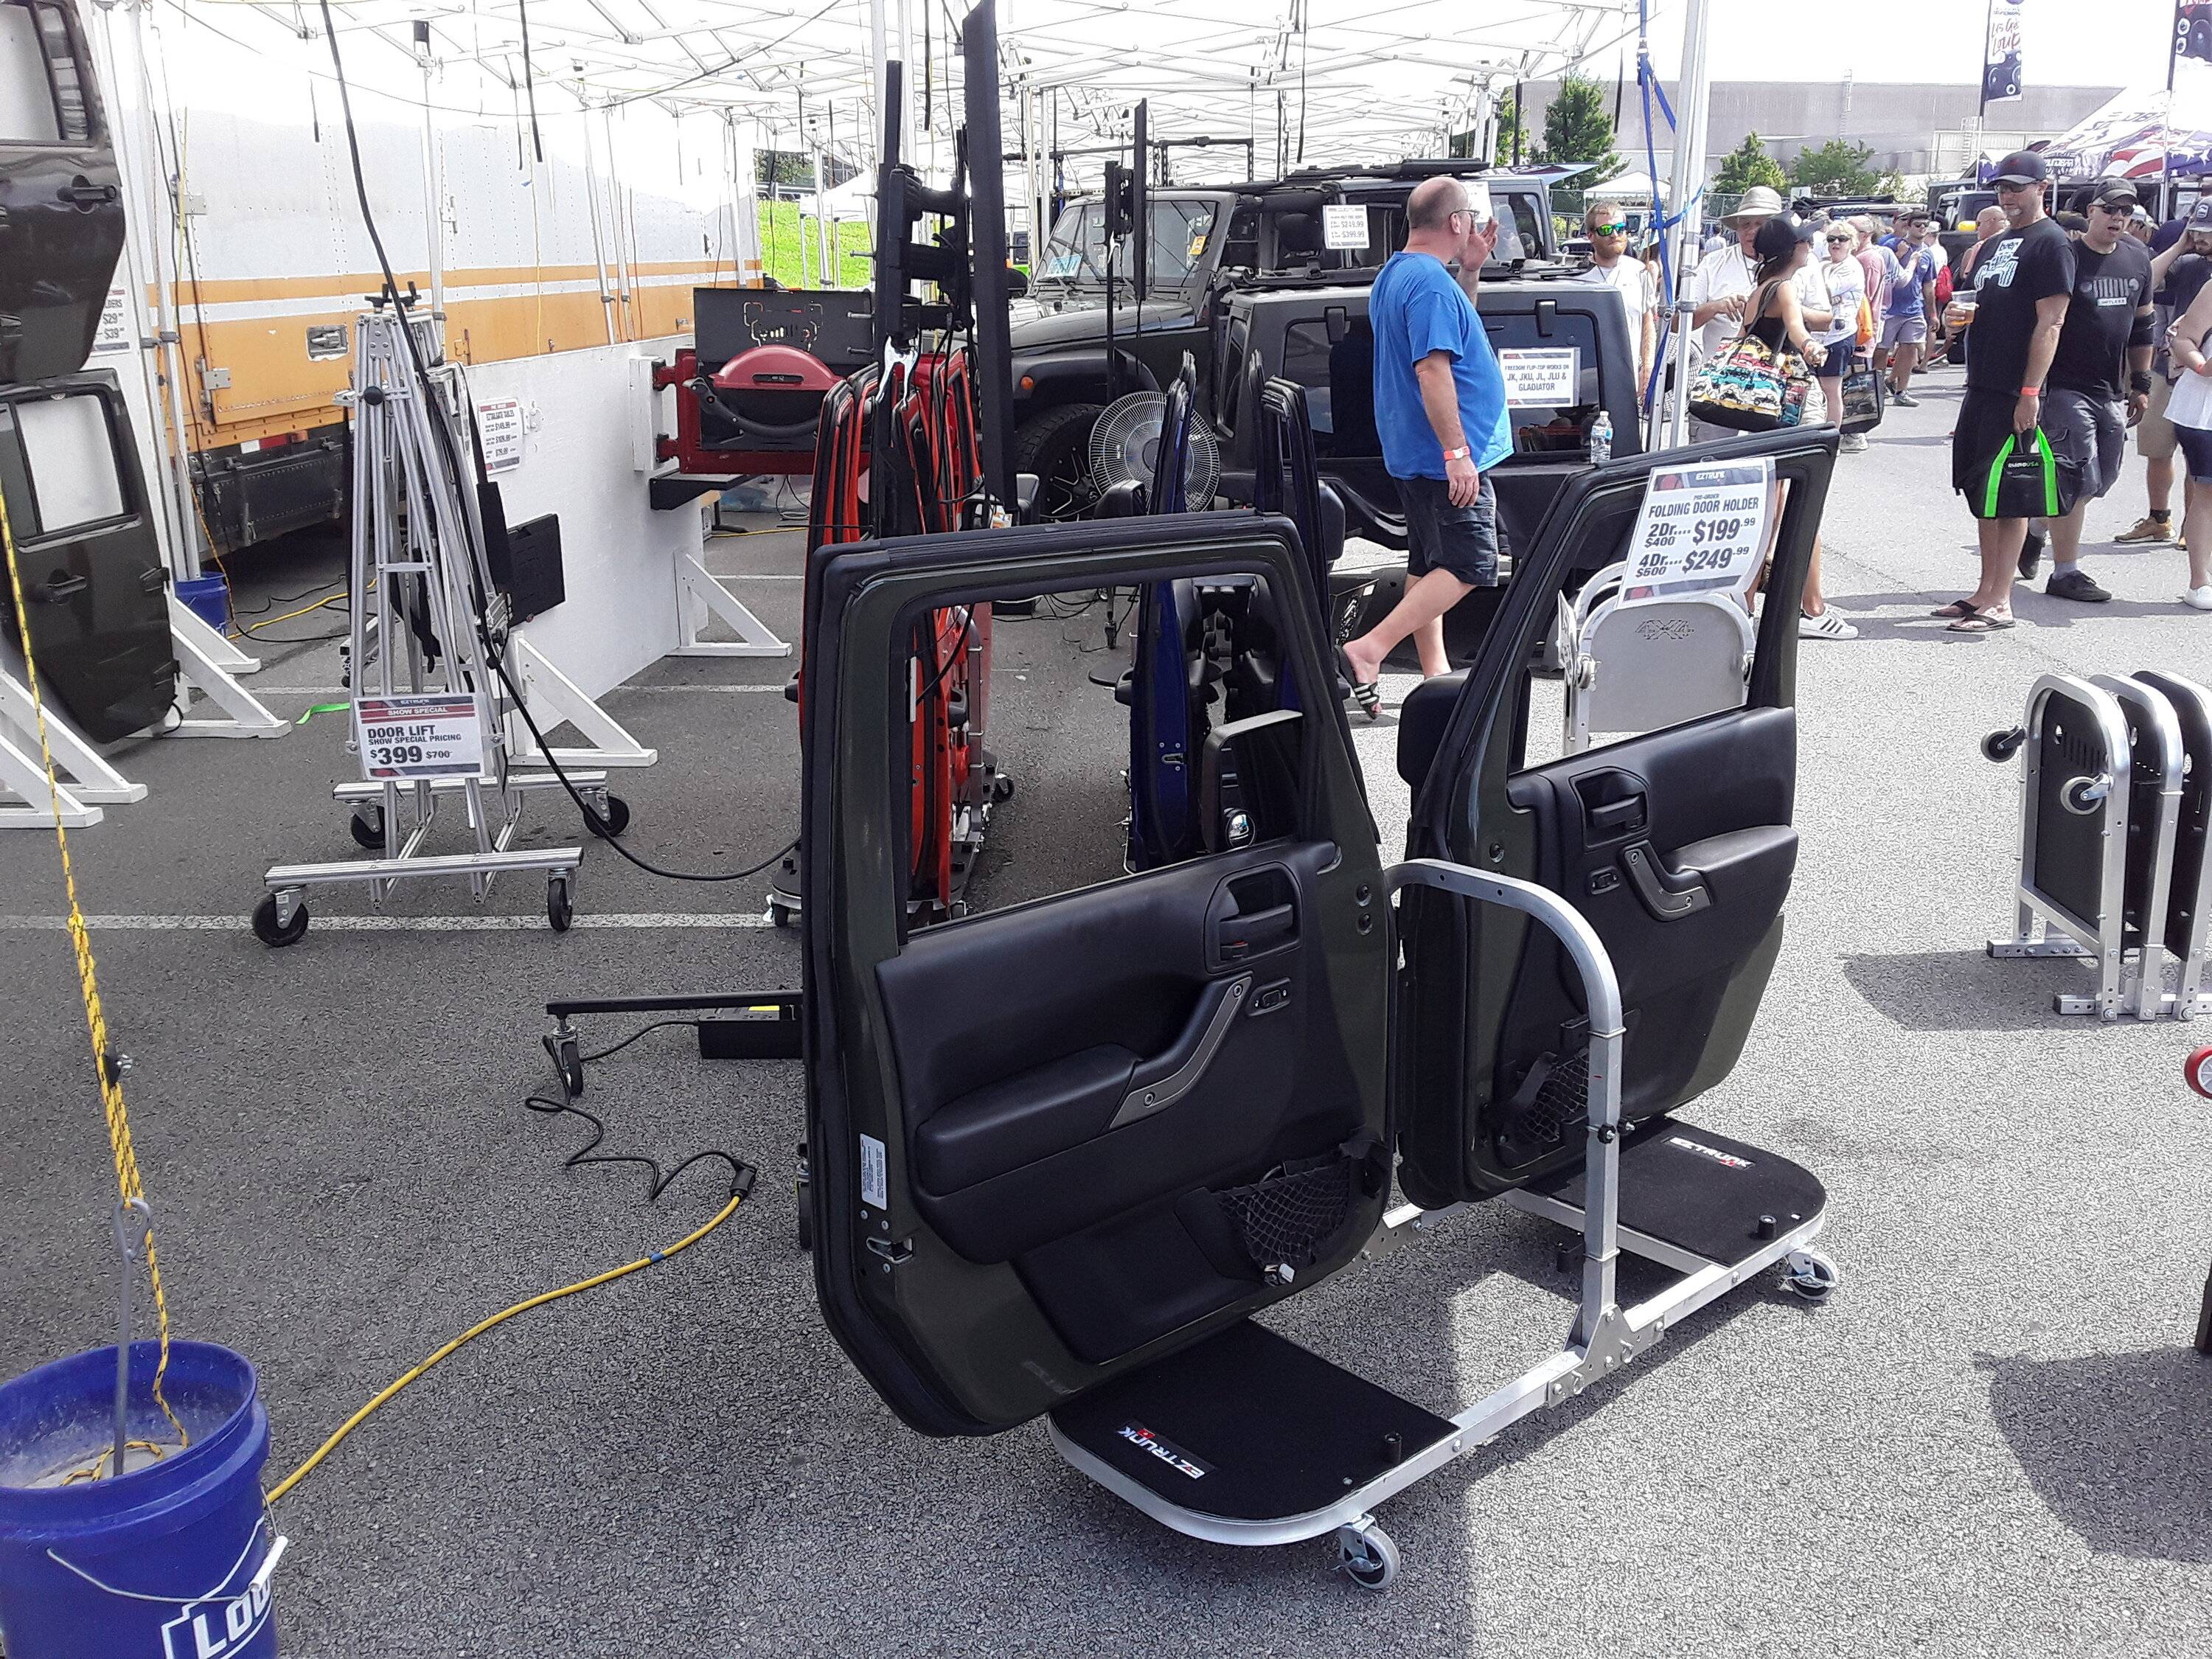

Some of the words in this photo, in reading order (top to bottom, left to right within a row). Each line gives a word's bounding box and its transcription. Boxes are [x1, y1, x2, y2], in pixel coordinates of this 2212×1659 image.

[1506, 372, 1517, 383] JK,
[1519, 372, 1534, 382] JKU,
[1536, 372, 1545, 381] JL,
[1547, 372, 1559, 380] JLU
[1561, 372, 1567, 380] &
[1518, 383, 1555, 392] GLADIATOR
[1648, 501, 1691, 518] FOLDING
[1692, 499, 1721, 515] DOOR
[1722, 496, 1759, 512] HOLDER
[1644, 536, 1675, 549] $400
[1635, 566, 1667, 578] $500
[388, 709, 413, 717] SHOW
[414, 706, 448, 714] SPECIAL
[367, 726, 405, 738] DOOR
[408, 725, 436, 736] LIFT
[429, 734, 462, 742] PRICING
[370, 745, 422, 765] $399
[425, 750, 451, 759] $700
[1116, 1426, 1206, 1480] EZTRUNK
